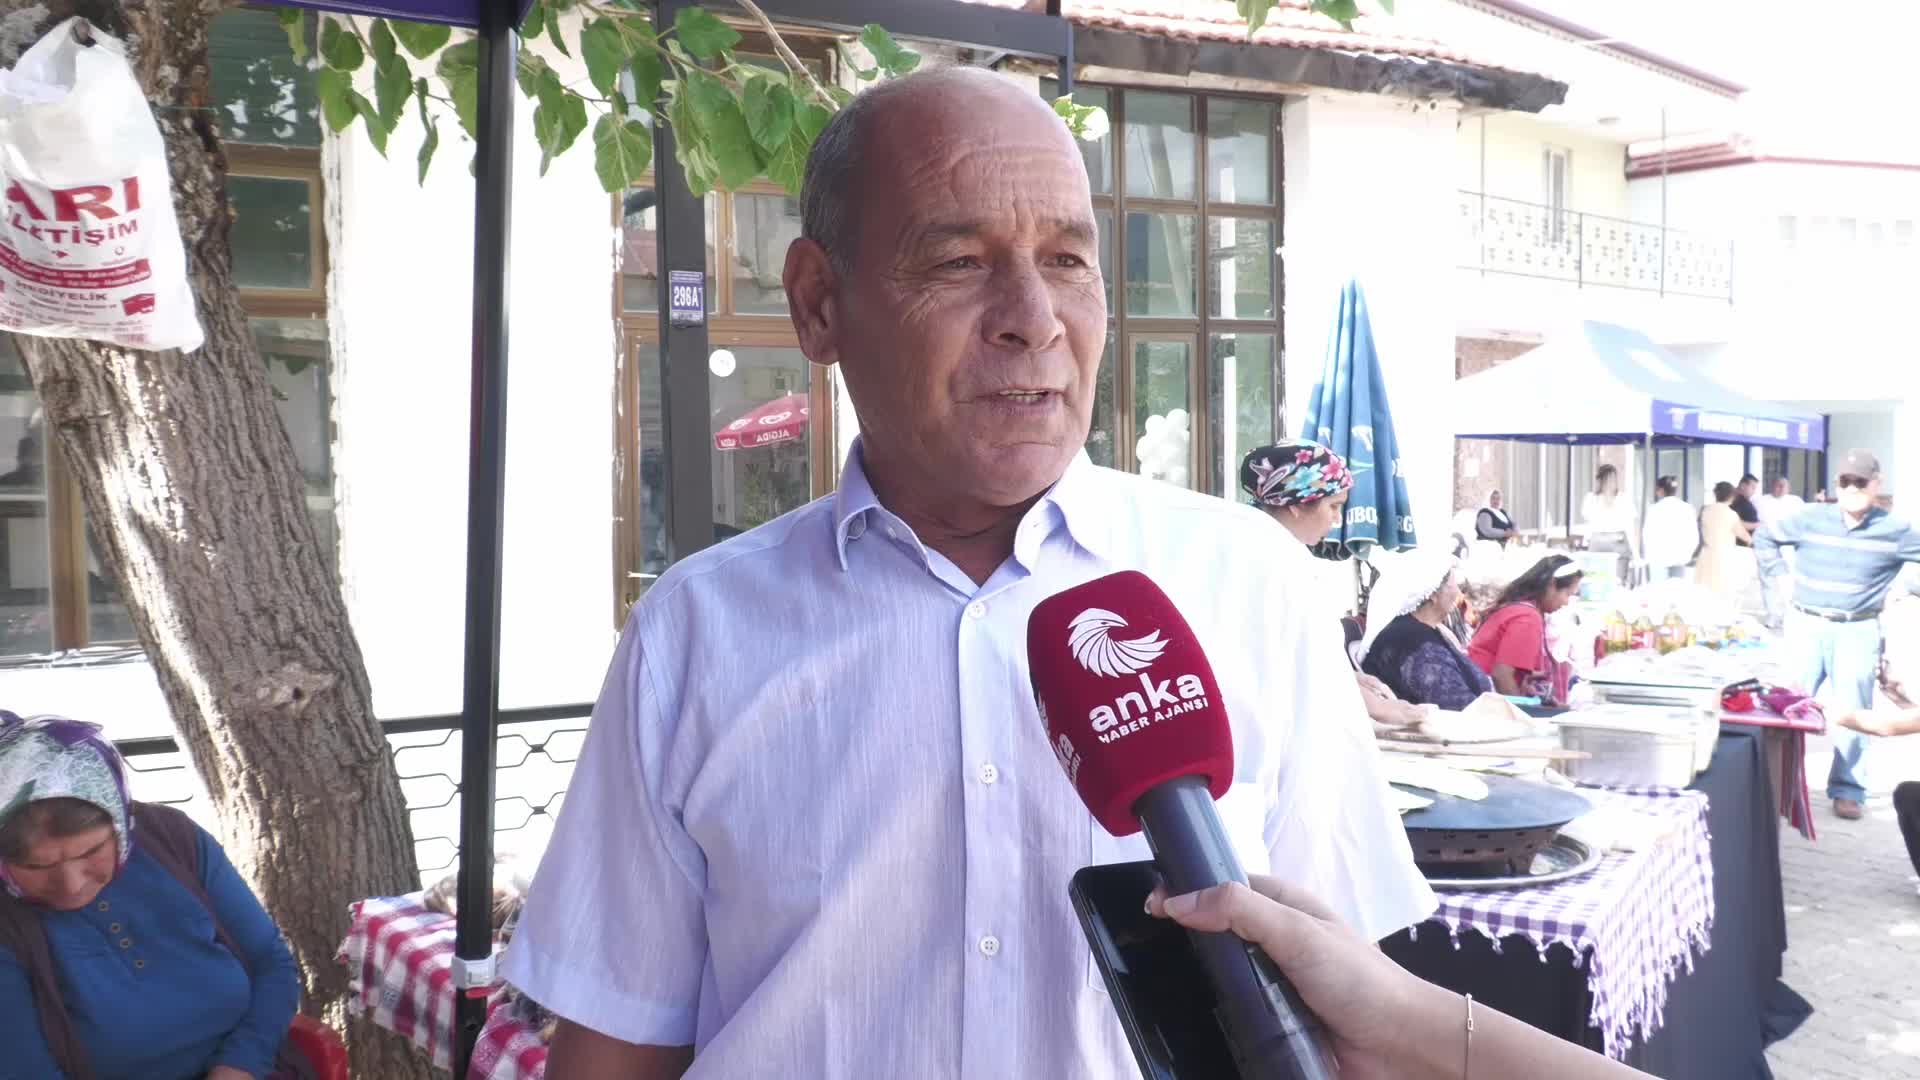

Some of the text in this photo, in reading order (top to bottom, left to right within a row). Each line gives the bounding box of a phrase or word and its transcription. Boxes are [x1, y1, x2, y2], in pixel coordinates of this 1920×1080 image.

[6, 176, 141, 222] ARI
[9, 206, 138, 246] LETİŞİM
[1089, 672, 1205, 732] anka
[1098, 697, 1209, 743] HABER AJANSI
